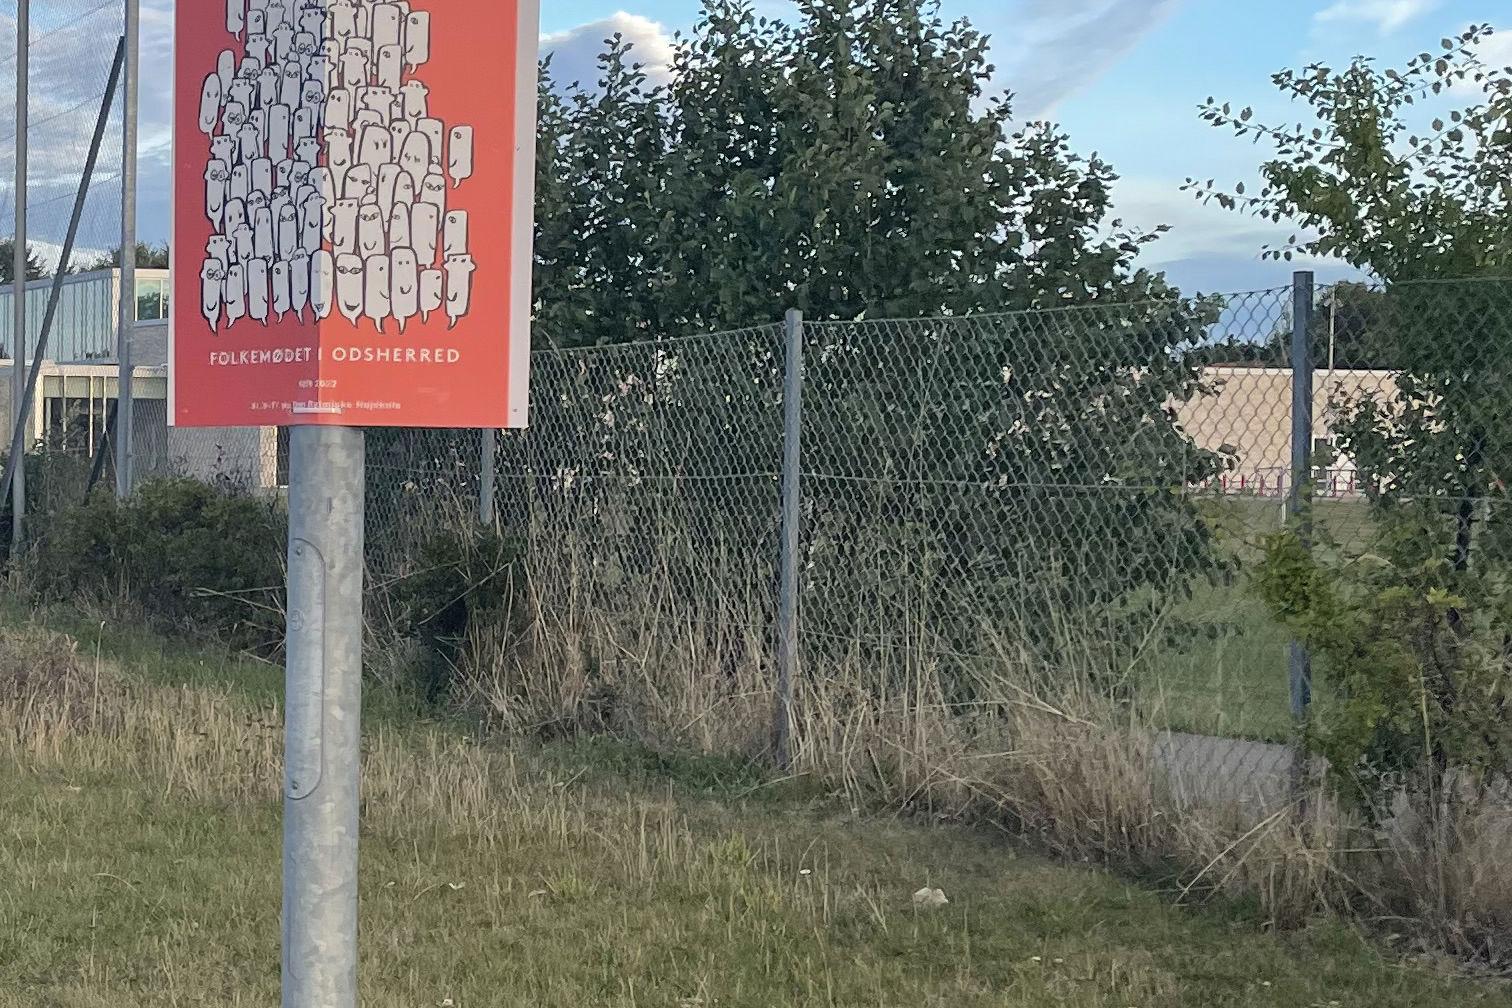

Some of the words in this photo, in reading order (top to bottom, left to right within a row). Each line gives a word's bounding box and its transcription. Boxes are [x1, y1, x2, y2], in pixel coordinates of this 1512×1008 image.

[209, 346, 312, 366] FOLKEMØDET
[317, 346, 323, 361] I
[331, 347, 460, 363] ODSHERRED
